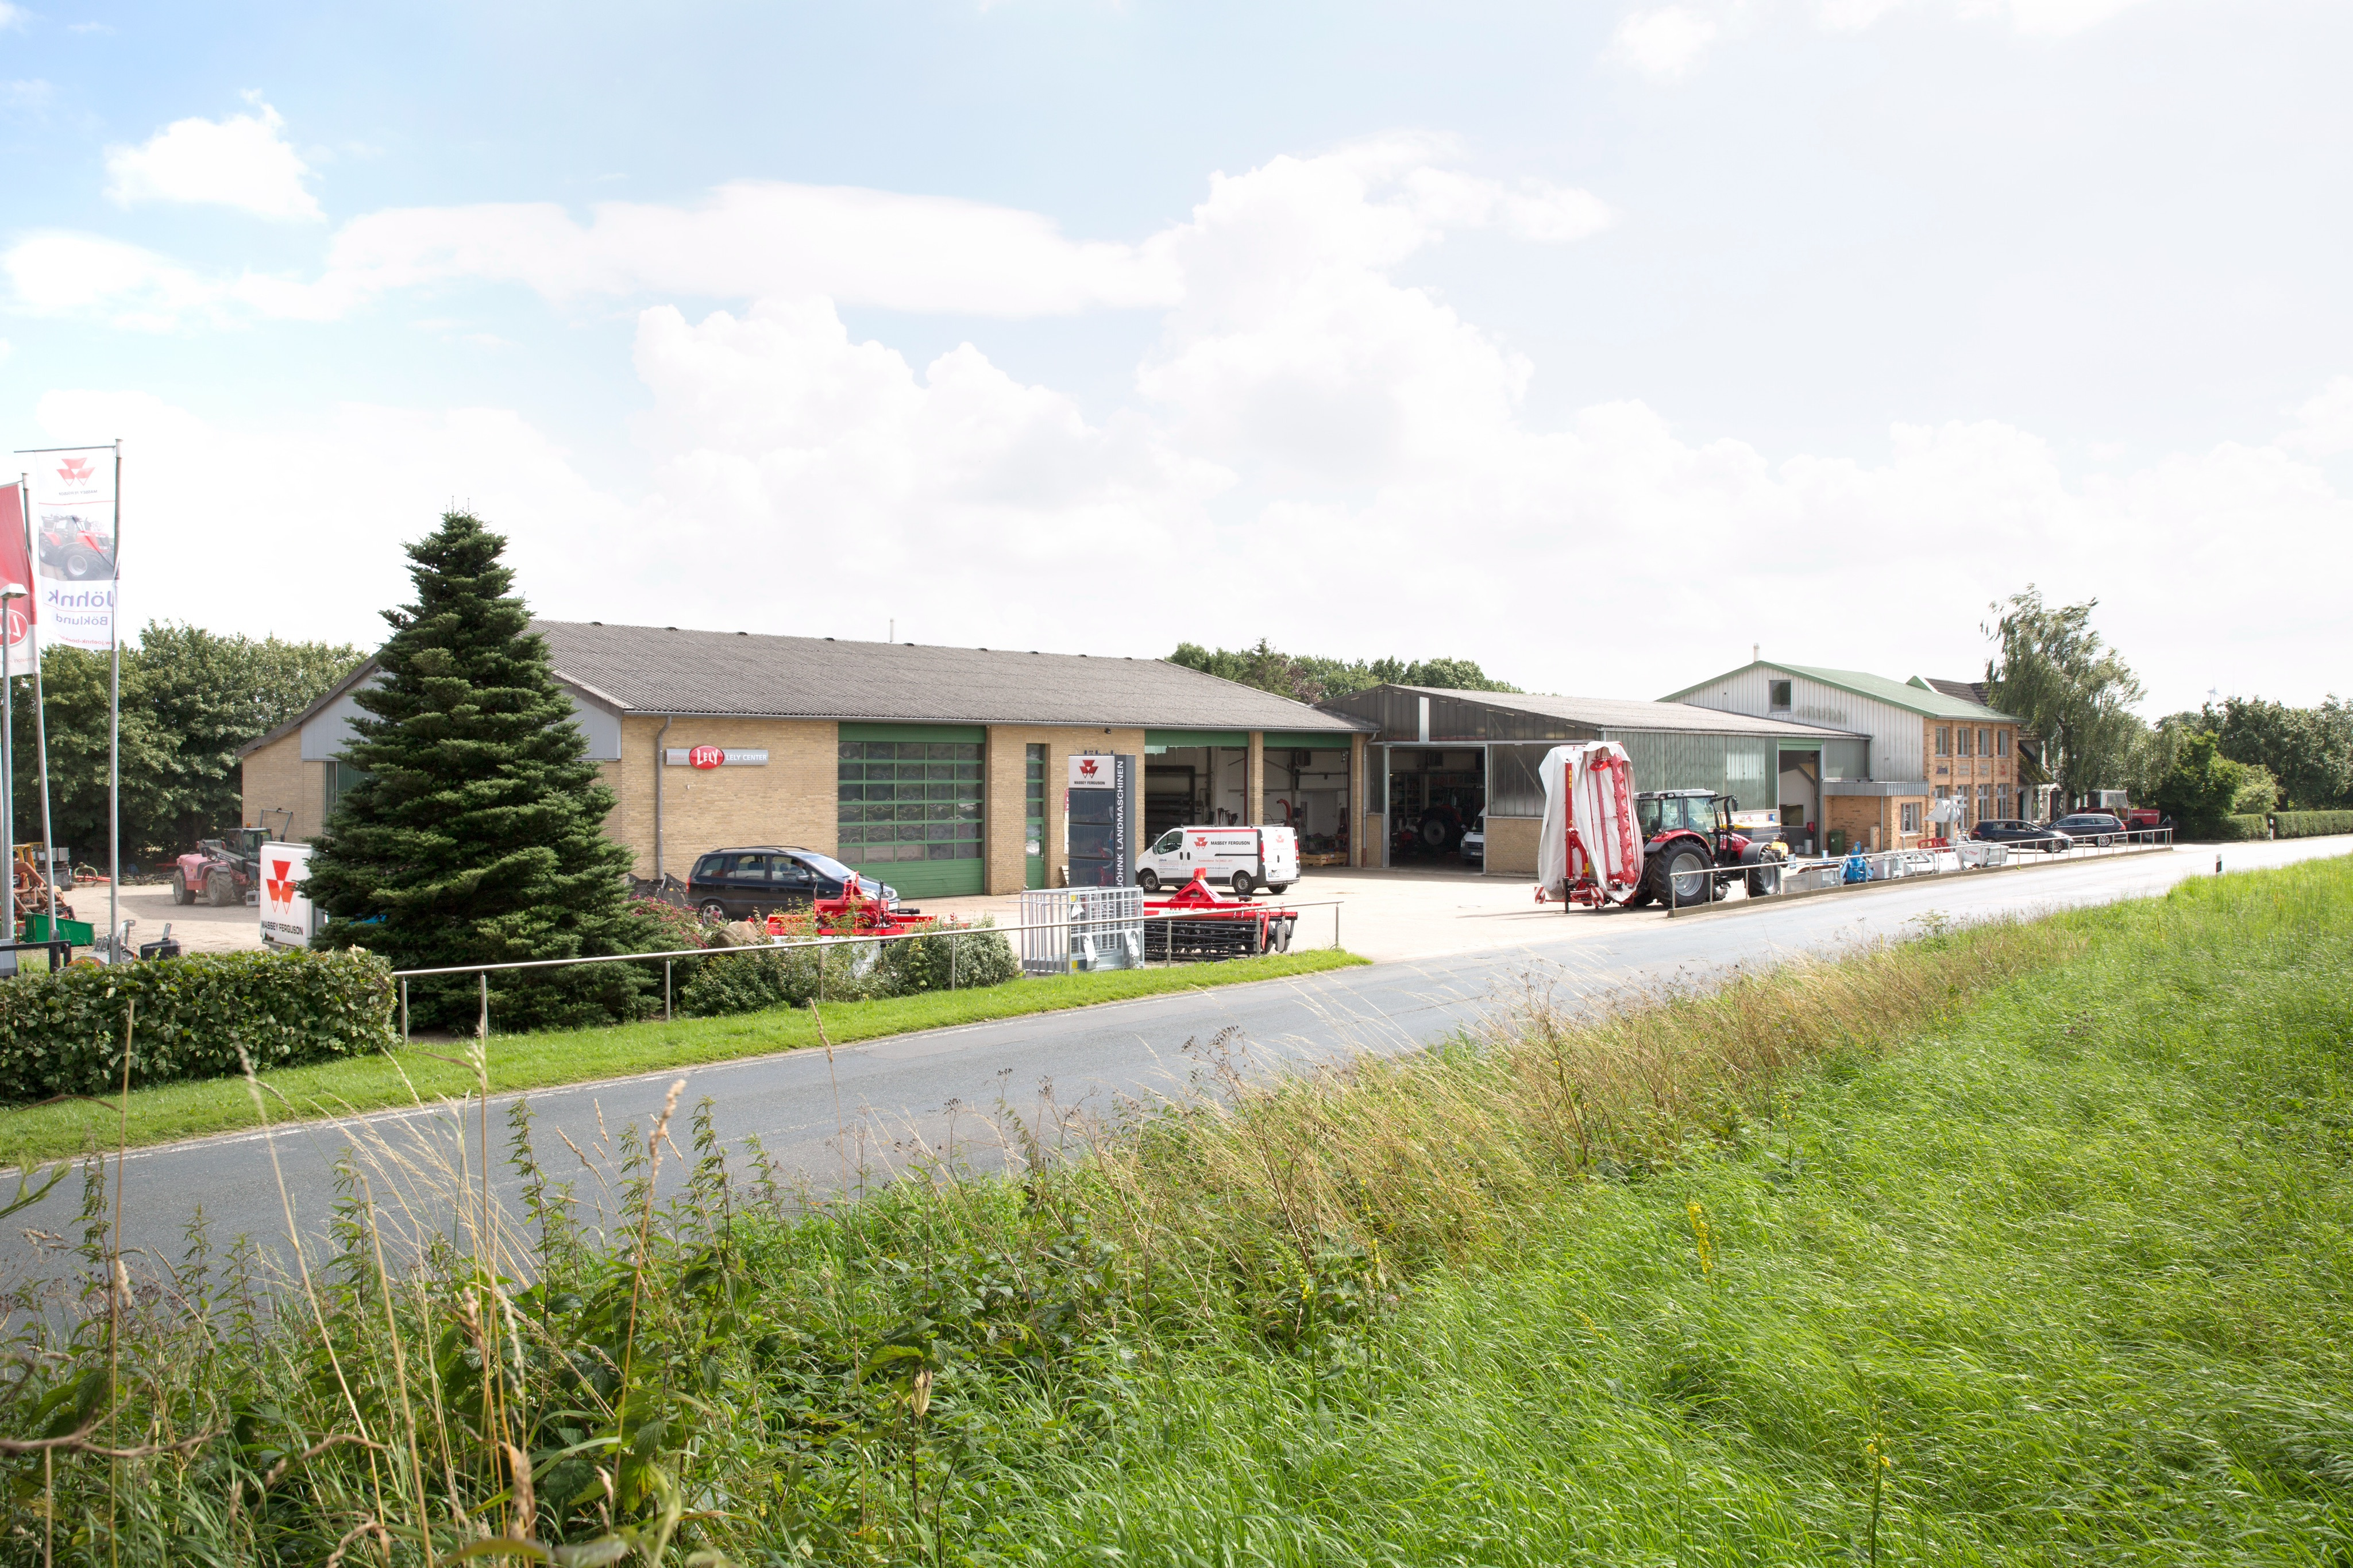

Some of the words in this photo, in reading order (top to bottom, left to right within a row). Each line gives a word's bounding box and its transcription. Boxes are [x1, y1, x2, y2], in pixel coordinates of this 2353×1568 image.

[696, 748, 719, 766] LELY
[1116, 853, 1124, 888] JÖHNK
[261, 920, 278, 931] MASSEY
[279, 923, 303, 936] FERGUSON
